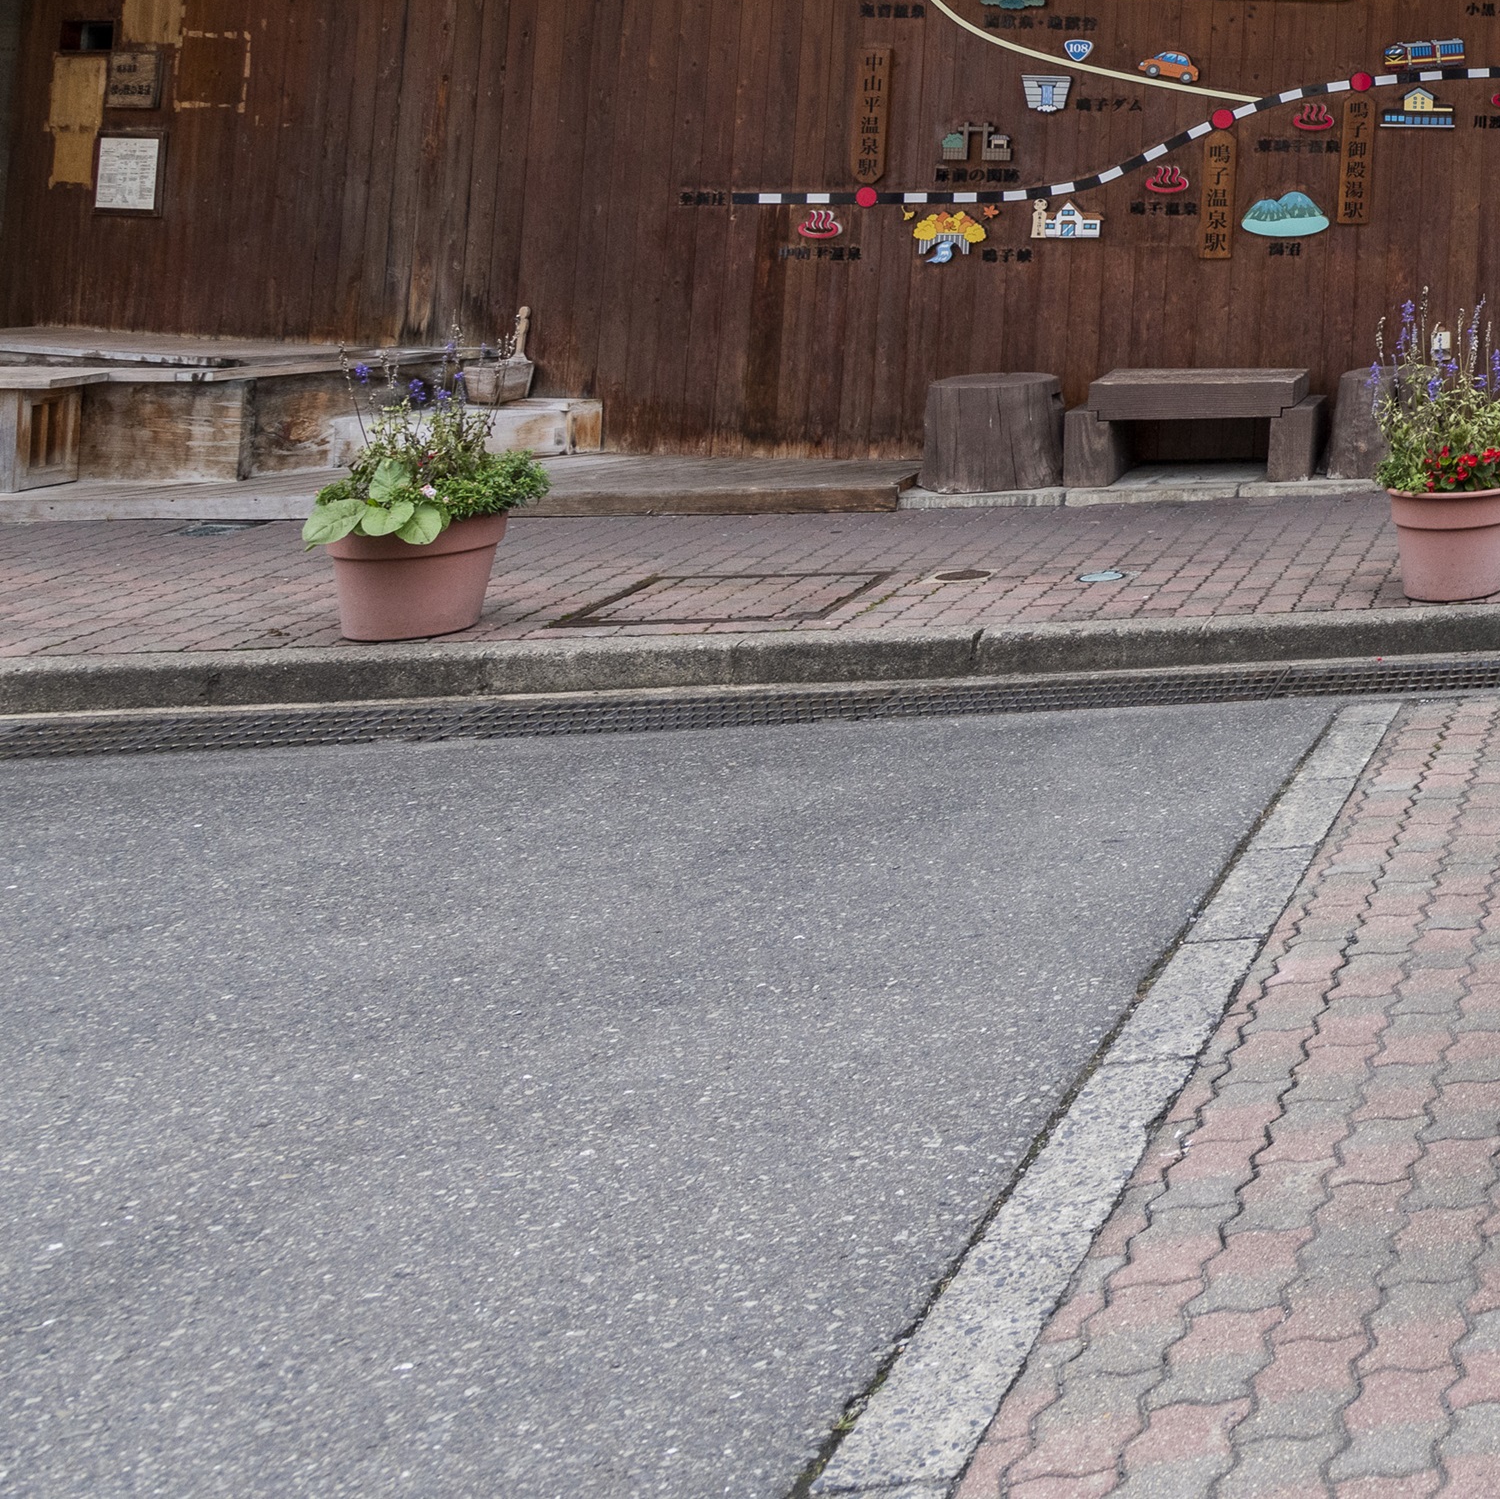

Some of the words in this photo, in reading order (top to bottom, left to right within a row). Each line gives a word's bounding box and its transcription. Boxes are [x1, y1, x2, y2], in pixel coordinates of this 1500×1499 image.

[1068, 43, 1088, 54] 108
[858, 54, 883, 177] 中山平温泉駅
[1343, 101, 1368, 218] 鳴子御殿湯駅
[1204, 145, 1231, 252] 鳴子温泉駅
